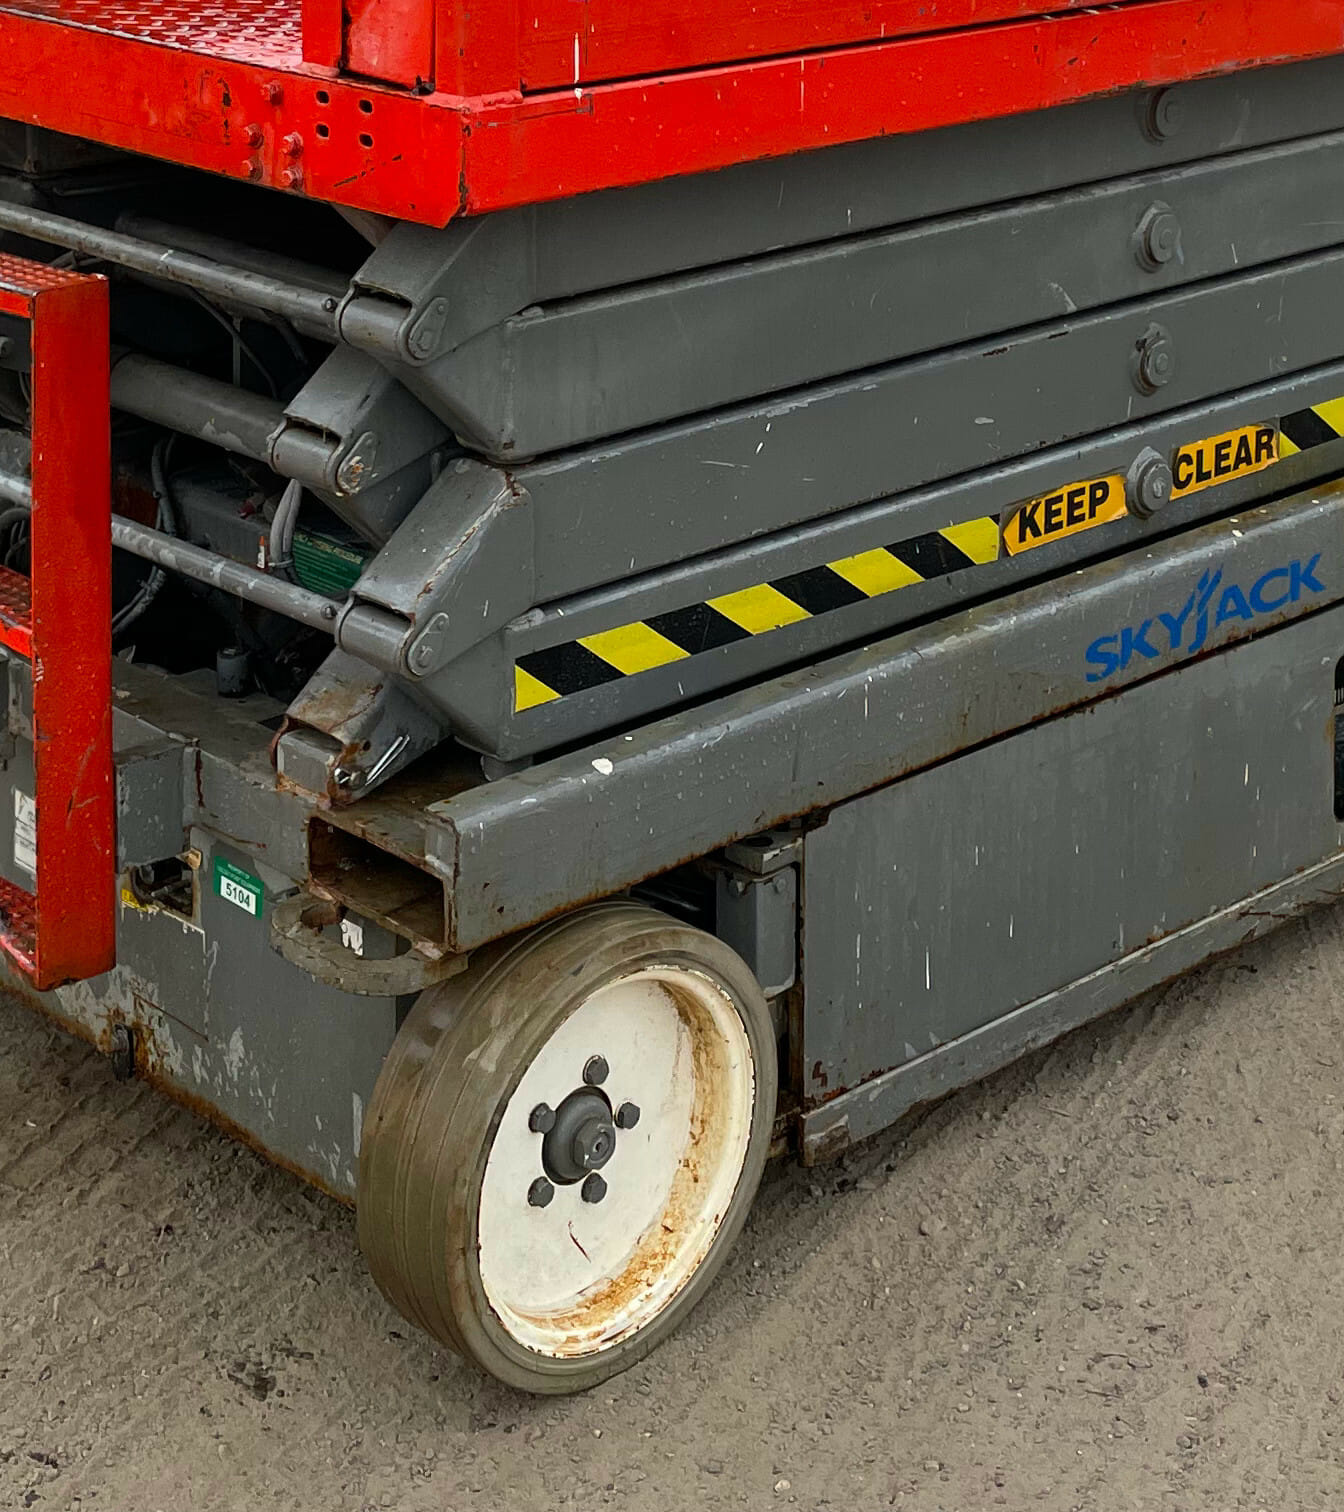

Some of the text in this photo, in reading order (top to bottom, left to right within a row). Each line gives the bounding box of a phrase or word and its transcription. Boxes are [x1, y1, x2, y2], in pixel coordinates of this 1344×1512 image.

[1018, 429, 1275, 543] KEEP CLEAR
[1085, 554, 1326, 682] SKYJACK
[226, 882, 250, 907] 5104
